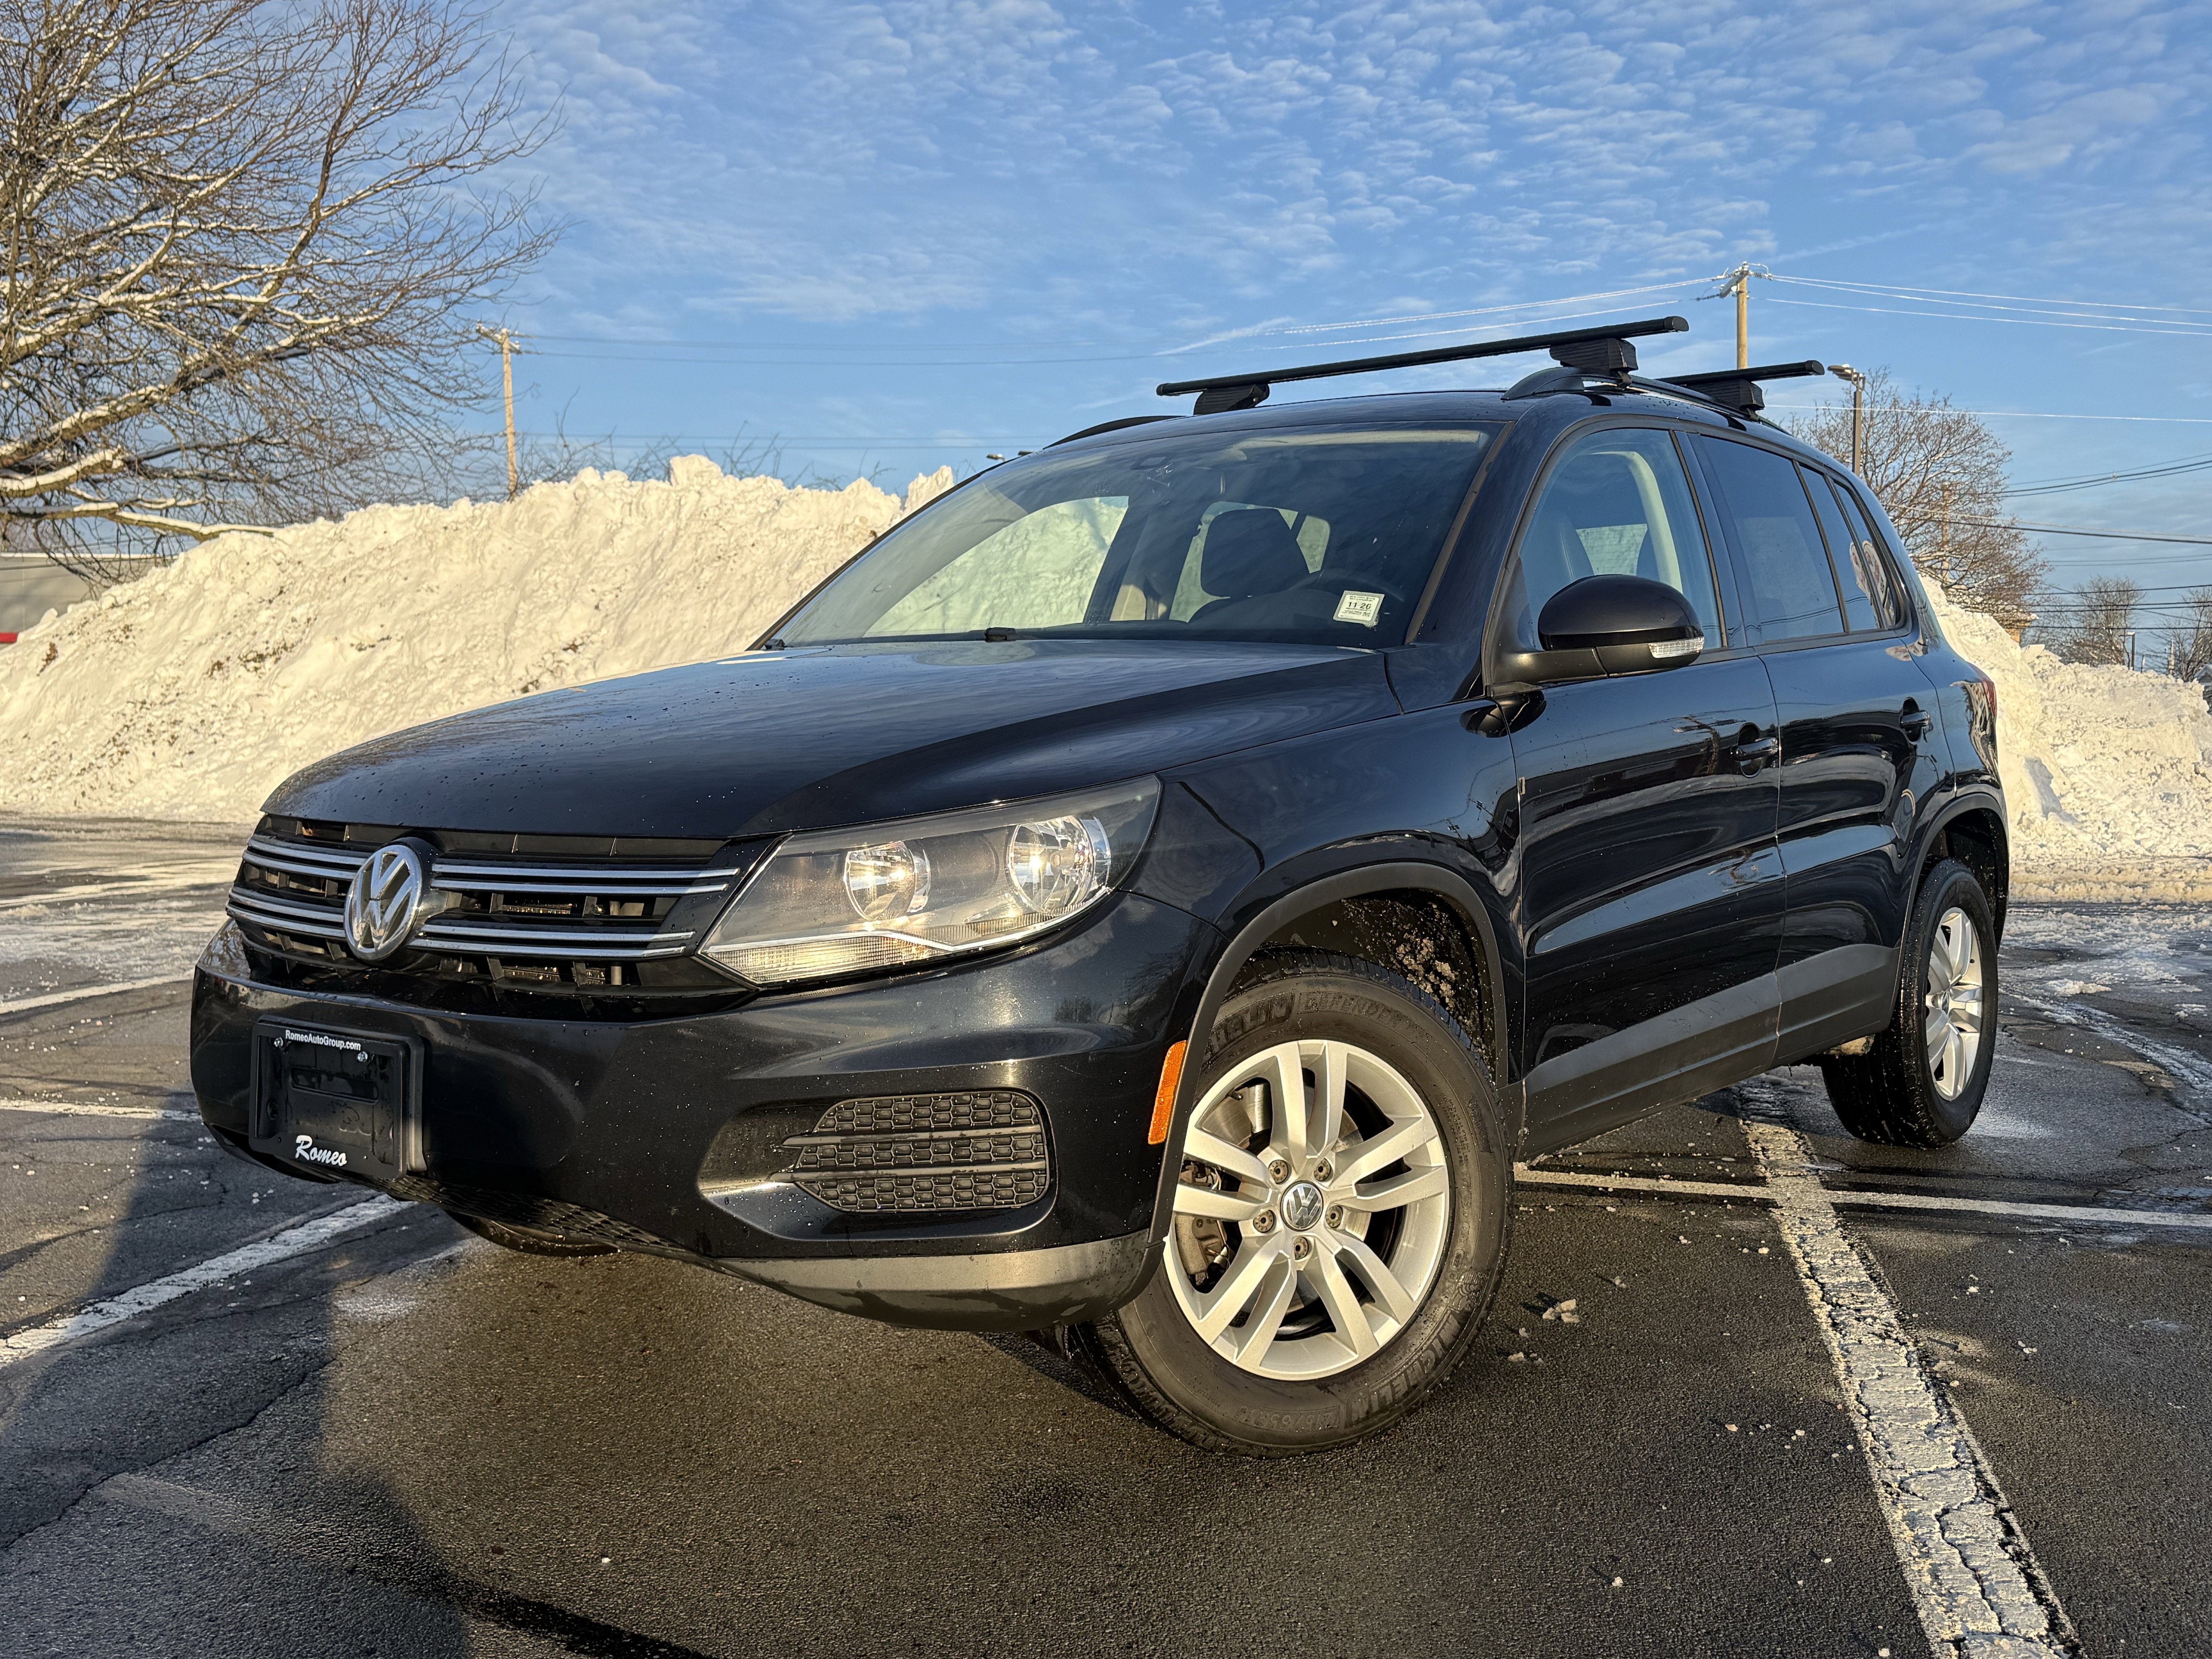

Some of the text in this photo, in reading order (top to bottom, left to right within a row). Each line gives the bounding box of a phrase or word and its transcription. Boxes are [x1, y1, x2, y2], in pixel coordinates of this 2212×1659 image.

[285, 1029, 361, 1051] RomeoAutoGroup.com
[295, 1135, 347, 1166] Romeo
[1352, 1314, 1461, 1423] MICHELIN
